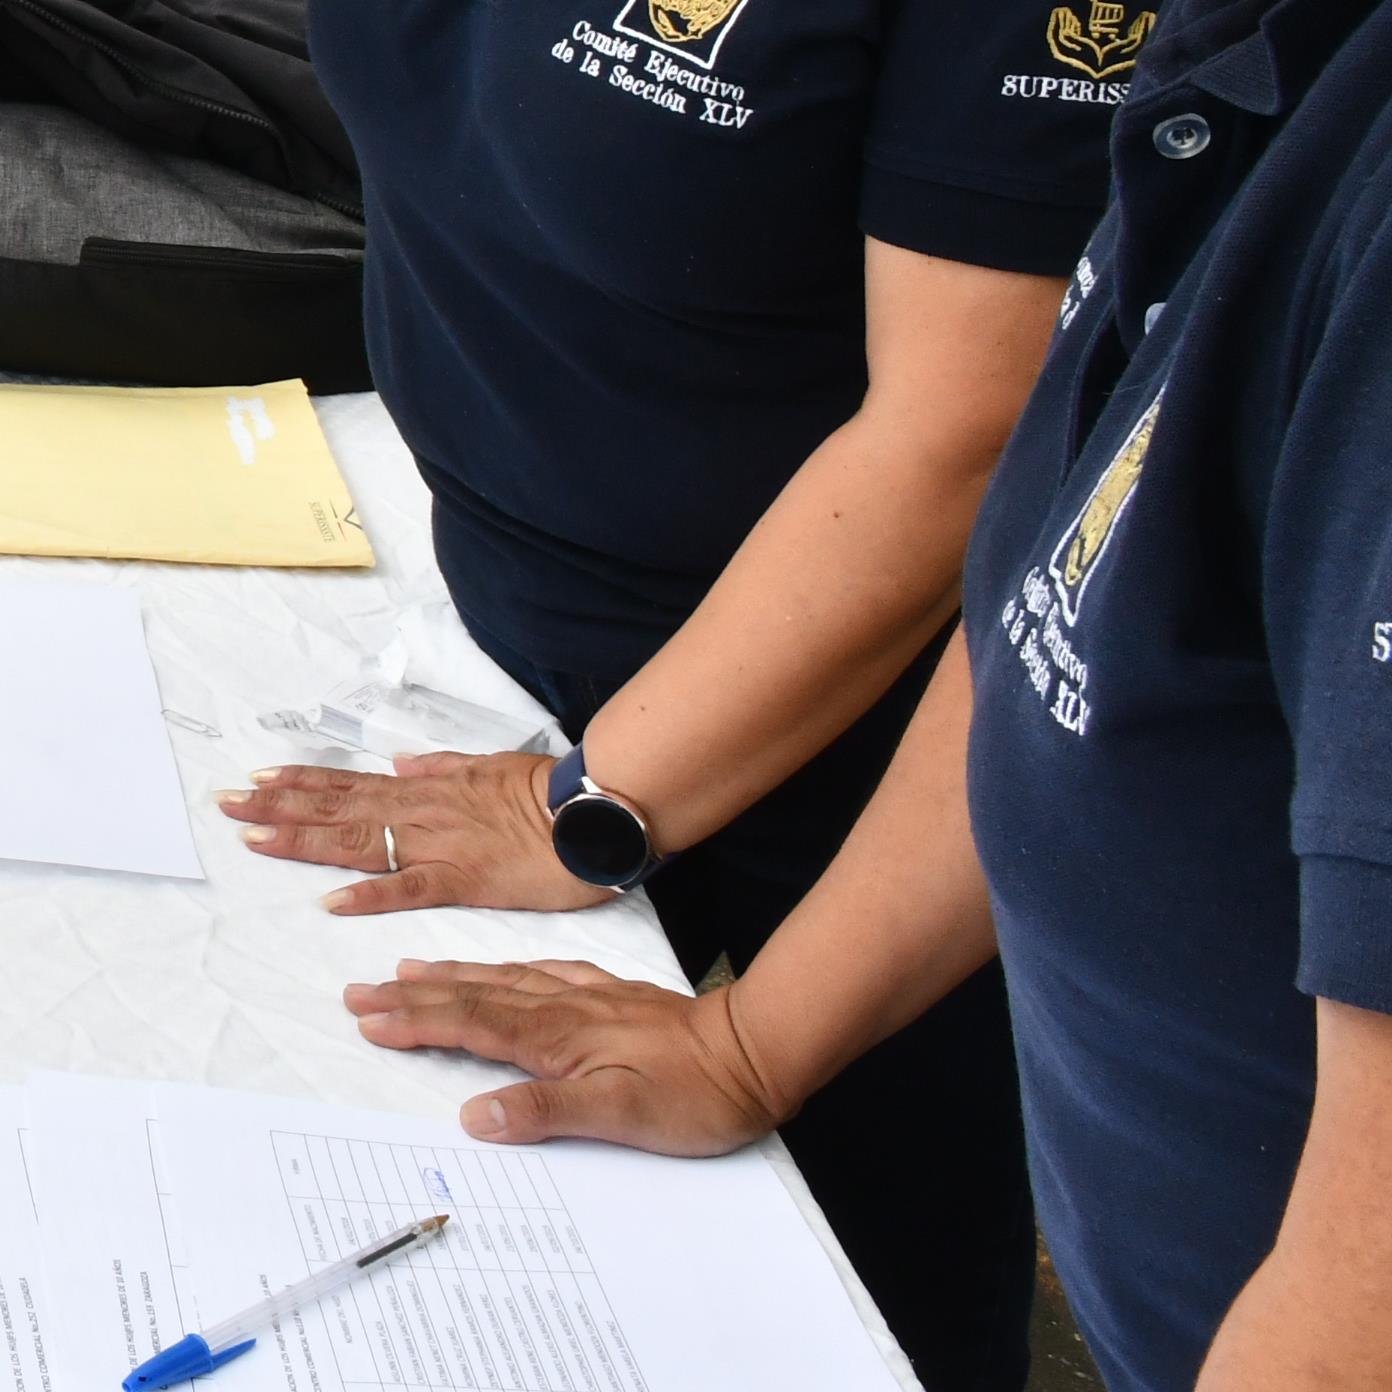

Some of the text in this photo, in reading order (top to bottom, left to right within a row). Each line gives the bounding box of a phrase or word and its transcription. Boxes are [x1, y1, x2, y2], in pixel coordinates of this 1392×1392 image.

[551, 38, 754, 129] de la Sección XLV
[572, 20, 744, 102] Comité Ejecutivo
